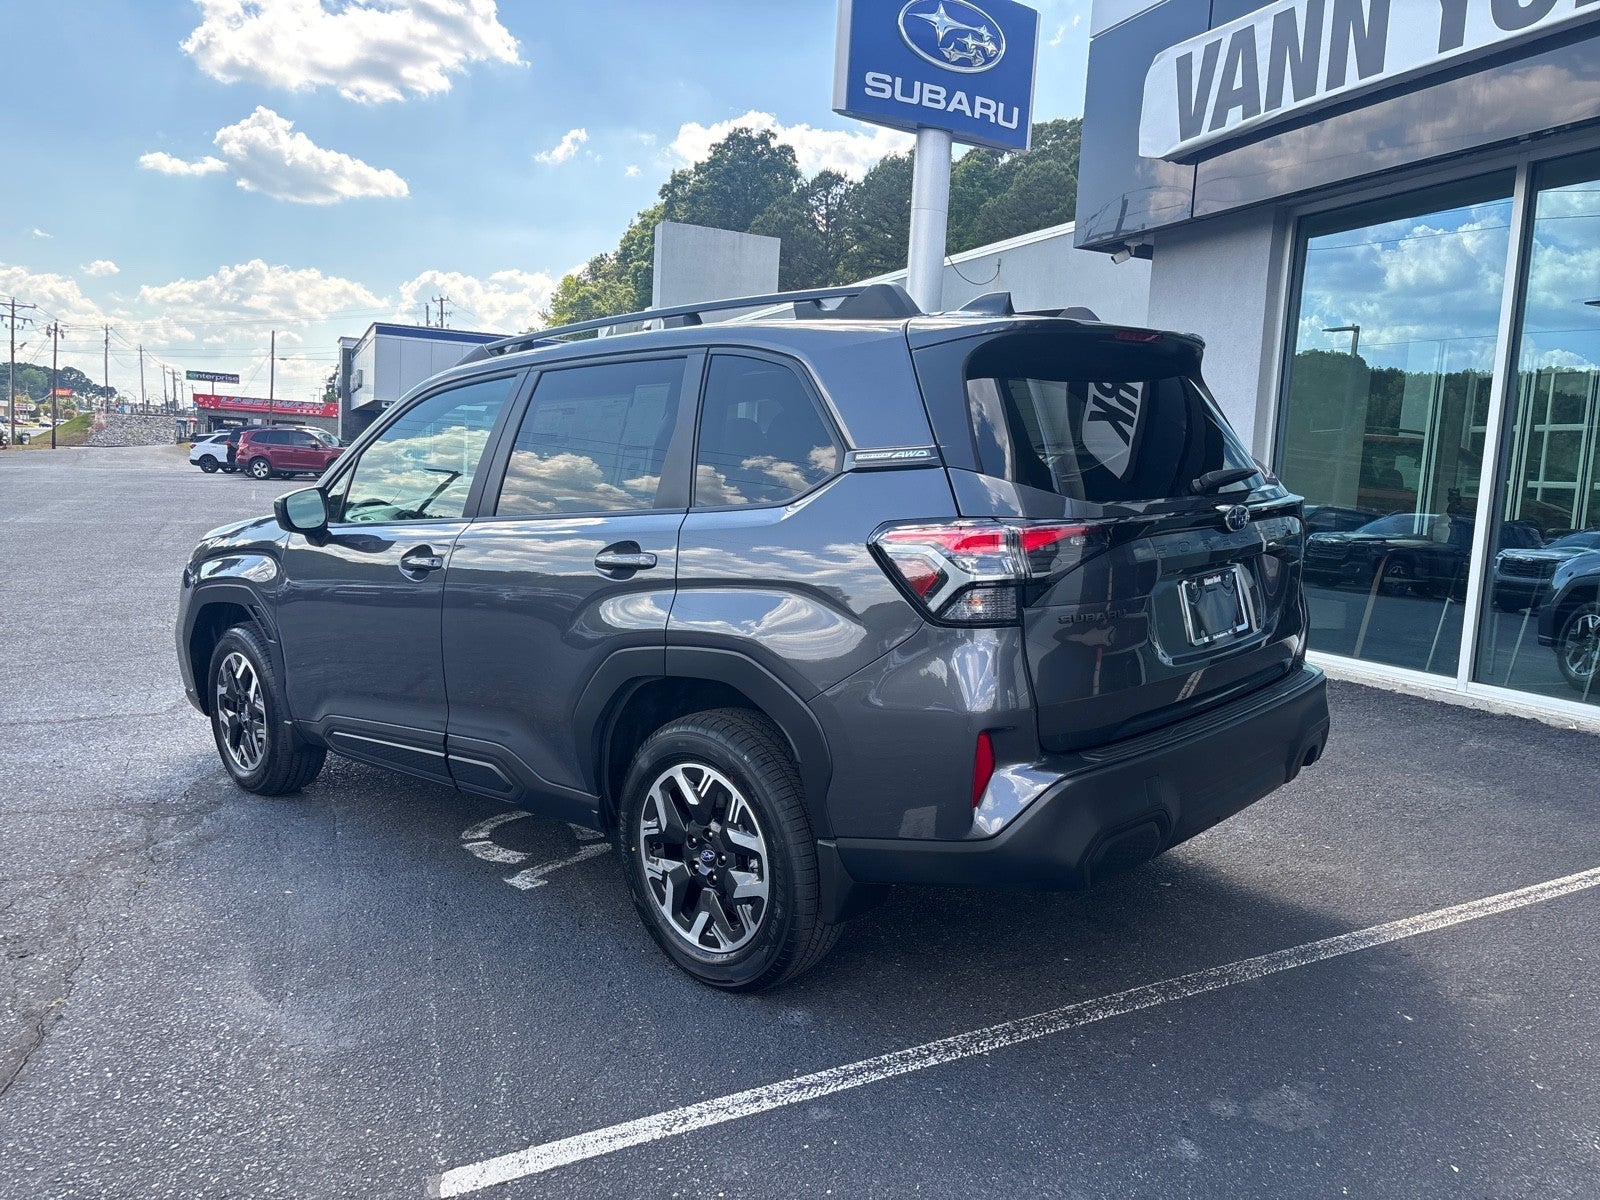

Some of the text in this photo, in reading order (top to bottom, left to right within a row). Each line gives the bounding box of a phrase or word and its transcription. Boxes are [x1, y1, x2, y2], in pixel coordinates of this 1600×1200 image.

[1176, 0, 1391, 143] VANN
[864, 71, 1019, 130] SUBARU
[188, 372, 239, 382] enterprise
[891, 449, 929, 459] AWD
[1058, 609, 1127, 624] SUBARU
